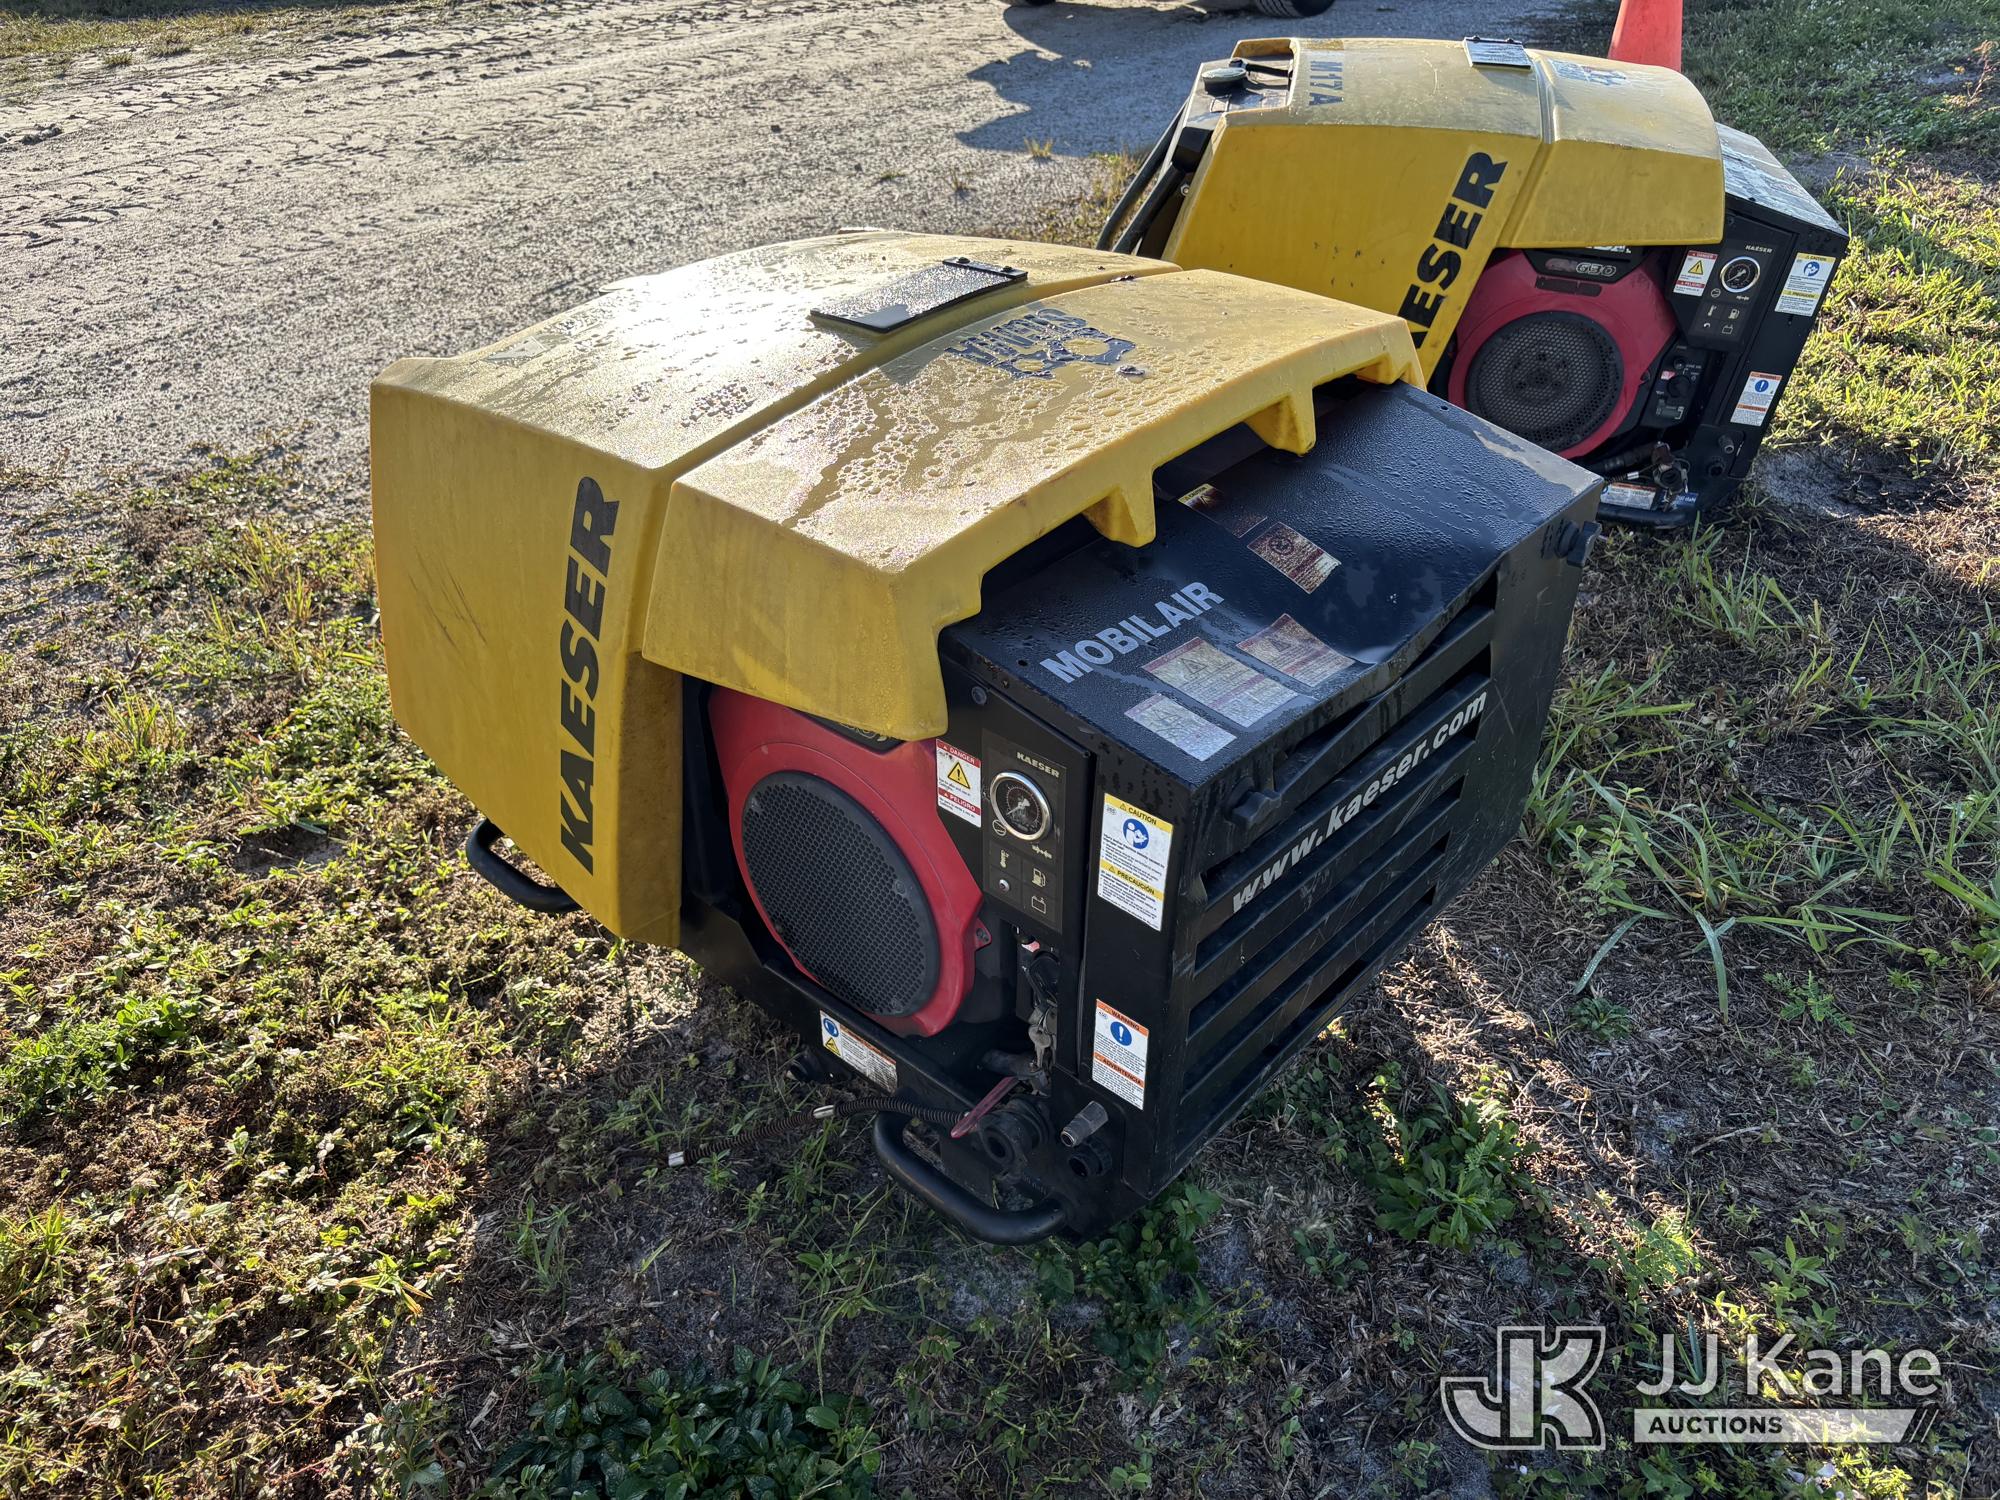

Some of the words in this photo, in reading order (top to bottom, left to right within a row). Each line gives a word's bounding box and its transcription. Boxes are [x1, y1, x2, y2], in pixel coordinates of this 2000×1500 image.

[1397, 150, 1508, 349] ESER
[1745, 244, 1773, 254] KAESER
[1040, 581, 1225, 684] MOBILAIR
[560, 476, 620, 876] KAESER
[949, 746, 976, 765] DANGER
[1016, 751, 1060, 778] KAESER
[948, 793, 977, 812] PELIGRO
[1127, 806, 1158, 826] CAUTION
[1233, 691, 1487, 914] www.kaeser.com
[1110, 1008, 1141, 1032] WARNING
[1102, 1056, 1144, 1087] ADVERTENCIA
